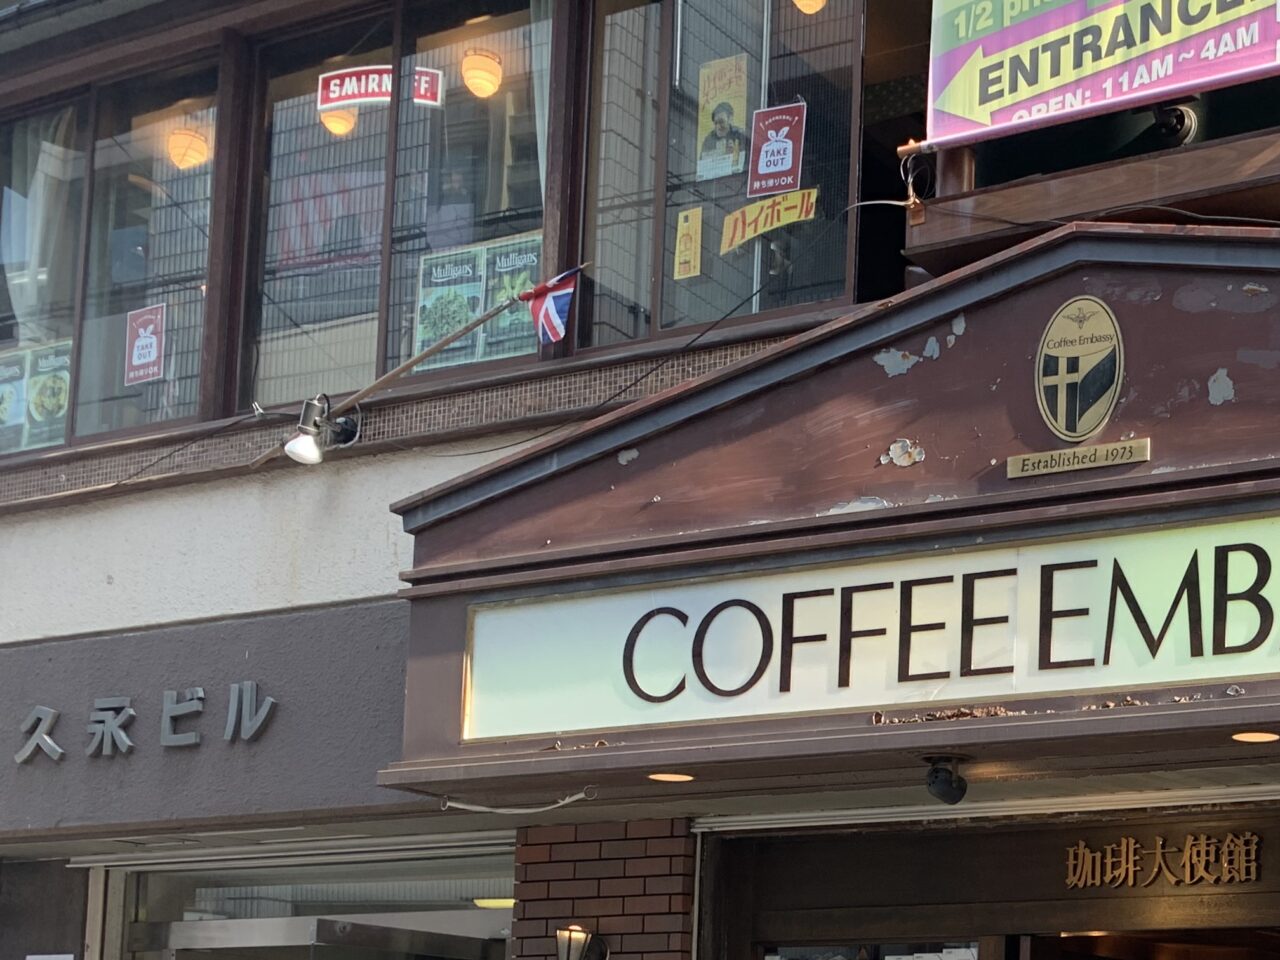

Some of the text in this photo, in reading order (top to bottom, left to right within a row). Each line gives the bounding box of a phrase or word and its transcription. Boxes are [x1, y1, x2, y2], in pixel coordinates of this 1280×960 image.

[954, 1, 993, 38] 1/2
[329, 74, 431, 98] SMIRNF.
[764, 147, 788, 159] TAKE
[765, 157, 786, 168] OUT
[728, 191, 815, 248] ハイボール
[431, 264, 473, 282] Mulligans
[495, 252, 538, 272] Mulligans
[1047, 333, 1115, 350] Coffee Embassy
[1021, 446, 1133, 473] Established 1973
[622, 568, 1018, 704] COFFEE
[15, 681, 278, 765] 久永ビル
[1065, 832, 1259, 889] 珈琲大使館
